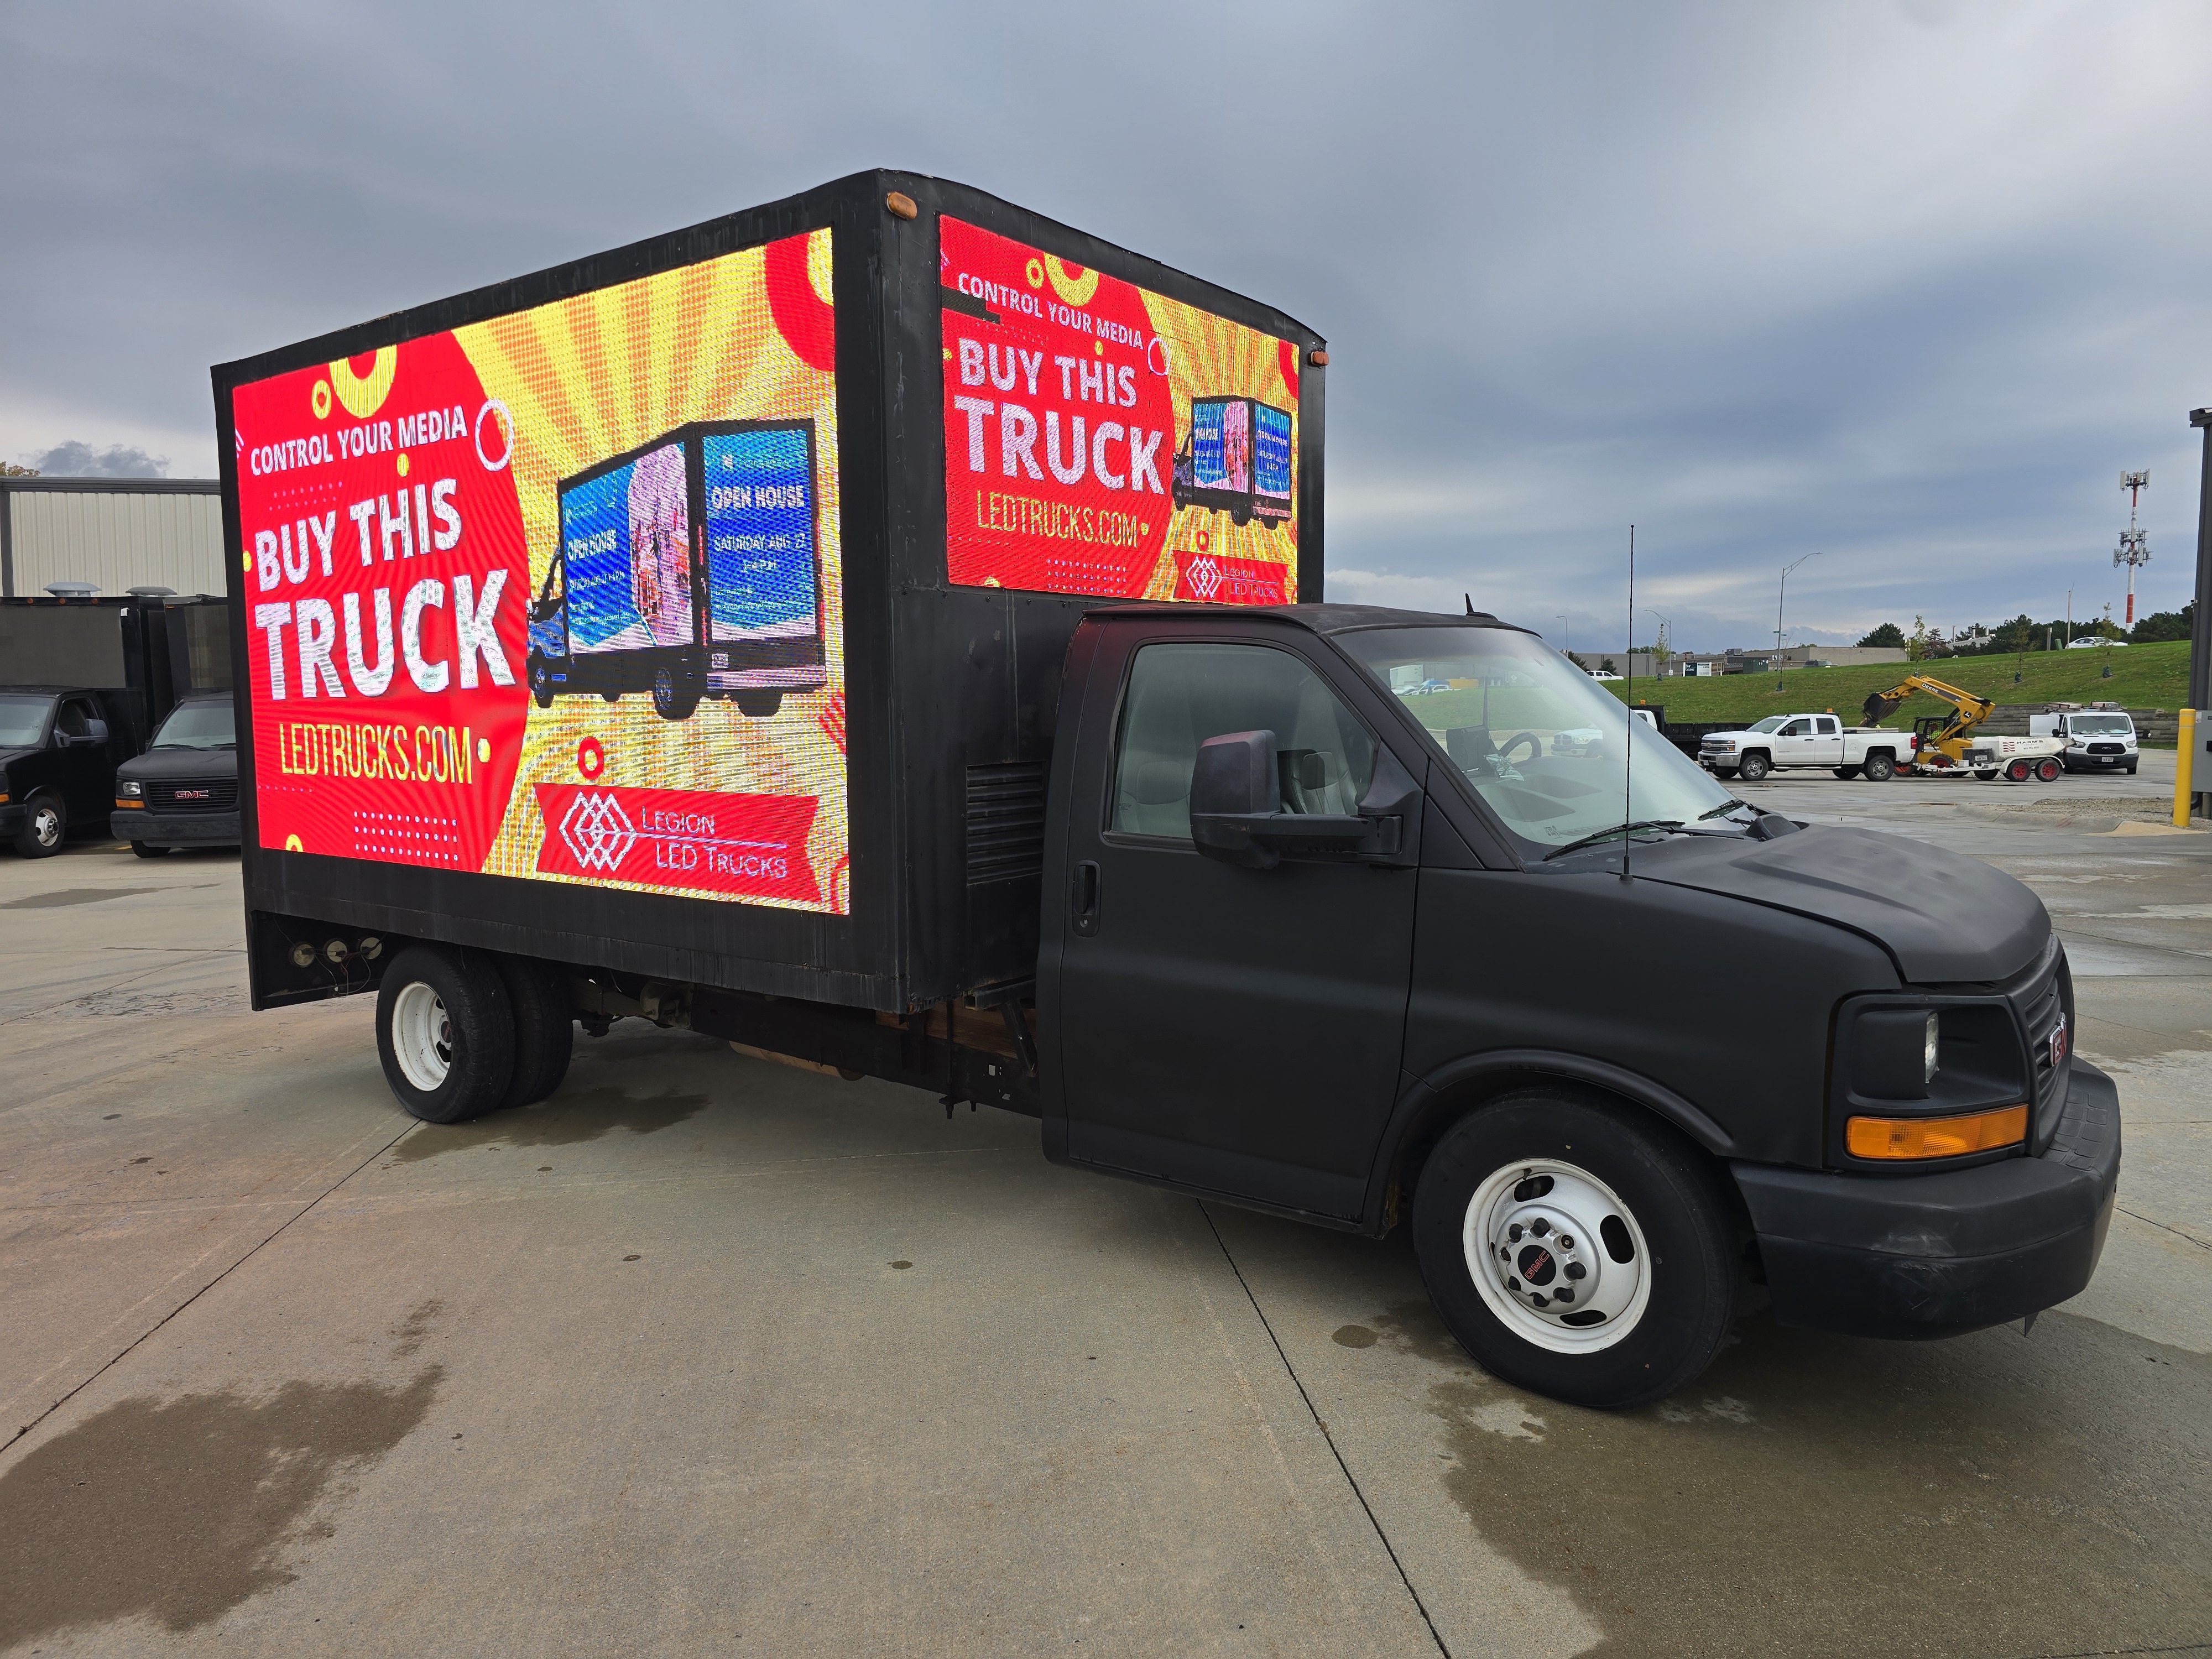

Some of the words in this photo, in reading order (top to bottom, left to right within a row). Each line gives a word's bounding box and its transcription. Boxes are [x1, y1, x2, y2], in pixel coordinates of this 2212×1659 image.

[958, 272, 1043, 319] CONTROL
[1047, 301, 1092, 333] YOUR
[1096, 318, 1143, 349] MEDIA
[958, 338, 1044, 395] BUY
[1054, 355, 1137, 408] THIS
[251, 434, 333, 476] CONTROL
[337, 421, 394, 459] YOUR
[398, 405, 468, 448] MEDIA
[954, 395, 1165, 494] TRUCK
[712, 486, 752, 510] OPEN
[755, 485, 805, 509] HOUSE
[977, 489, 1138, 547] LEDTRUCKS.COM
[254, 510, 337, 592] BUY
[349, 478, 462, 566] THIS
[1224, 565, 1255, 578] LEGION
[1229, 582, 1248, 596] LED
[1249, 584, 1279, 599] TRUCKS
[254, 569, 515, 701] TRUCK
[1921, 683, 1939, 693] DEERE
[279, 723, 473, 784] LEDTRUCKS.COM
[175, 790, 209, 799] GMC
[641, 806, 716, 834] LEGION
[655, 842, 698, 870] LED
[703, 846, 788, 879] TRUCKS
[1524, 1250, 1550, 1280] GMC
